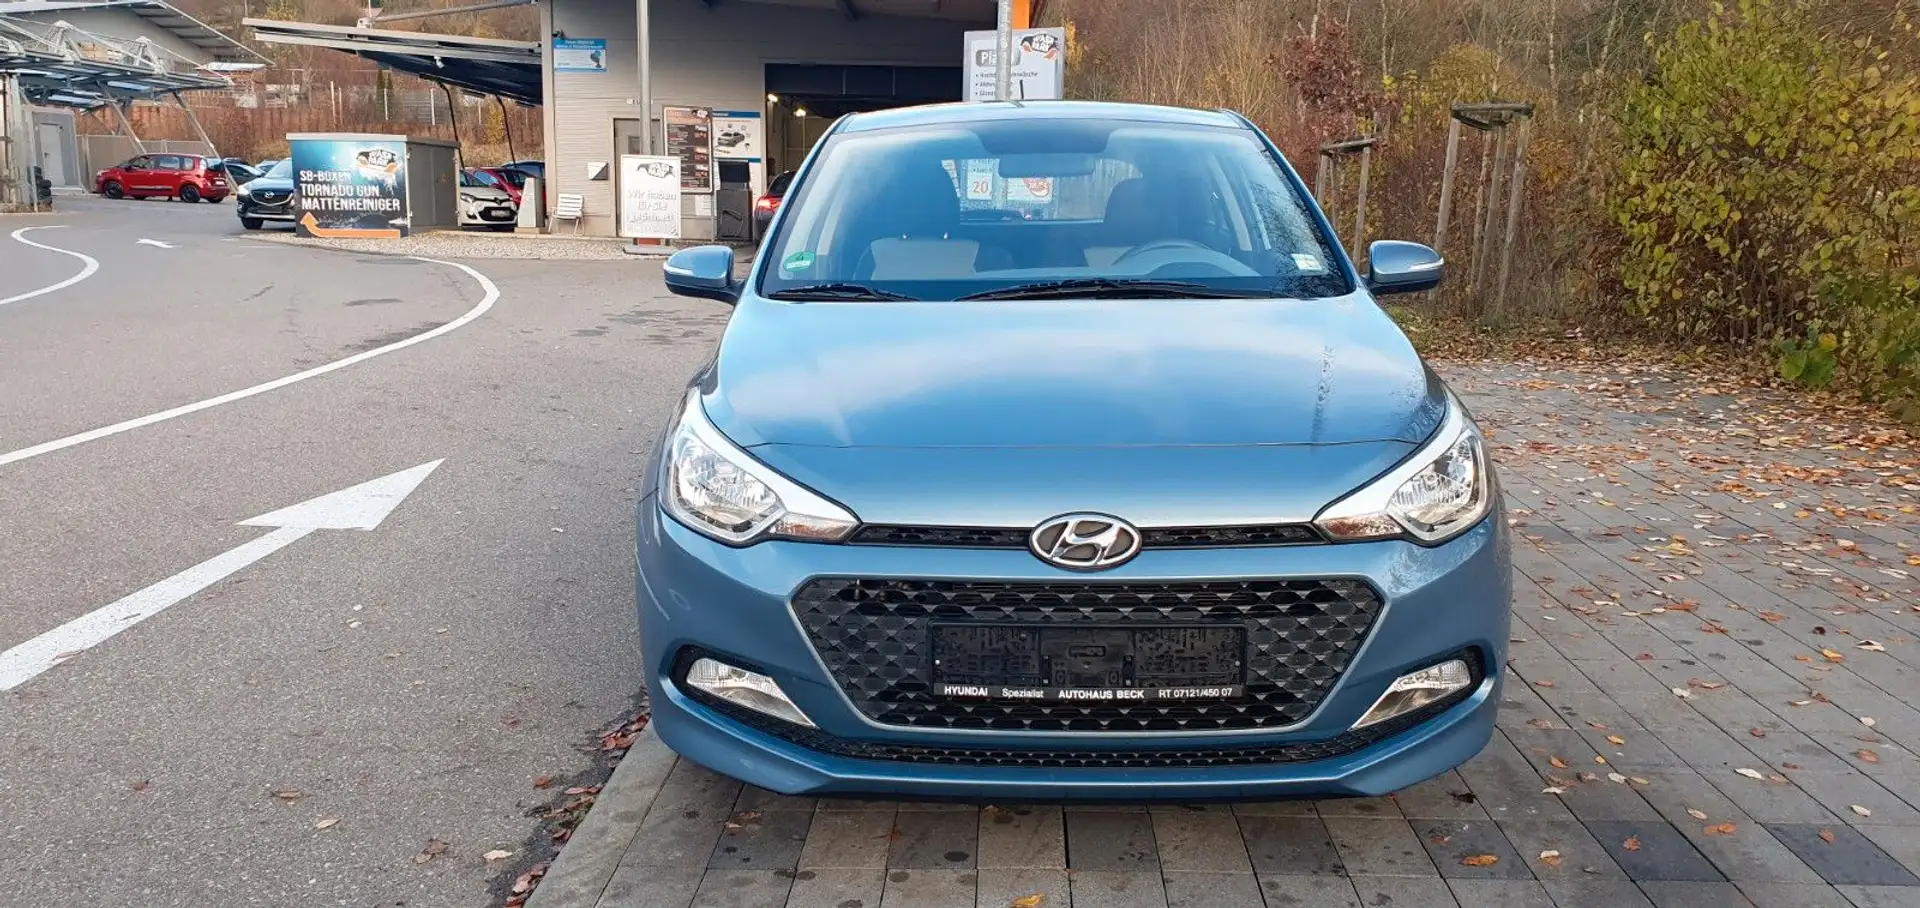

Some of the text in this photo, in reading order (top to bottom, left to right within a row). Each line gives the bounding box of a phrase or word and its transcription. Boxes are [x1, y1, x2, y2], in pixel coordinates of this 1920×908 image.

[300, 183, 353, 197] TORNADO
[302, 197, 400, 211] MATTENREINIGER
[944, 685, 1233, 699] HYUNDAI Spezialist AUTOHAUS BECK RT 07121/450 07
